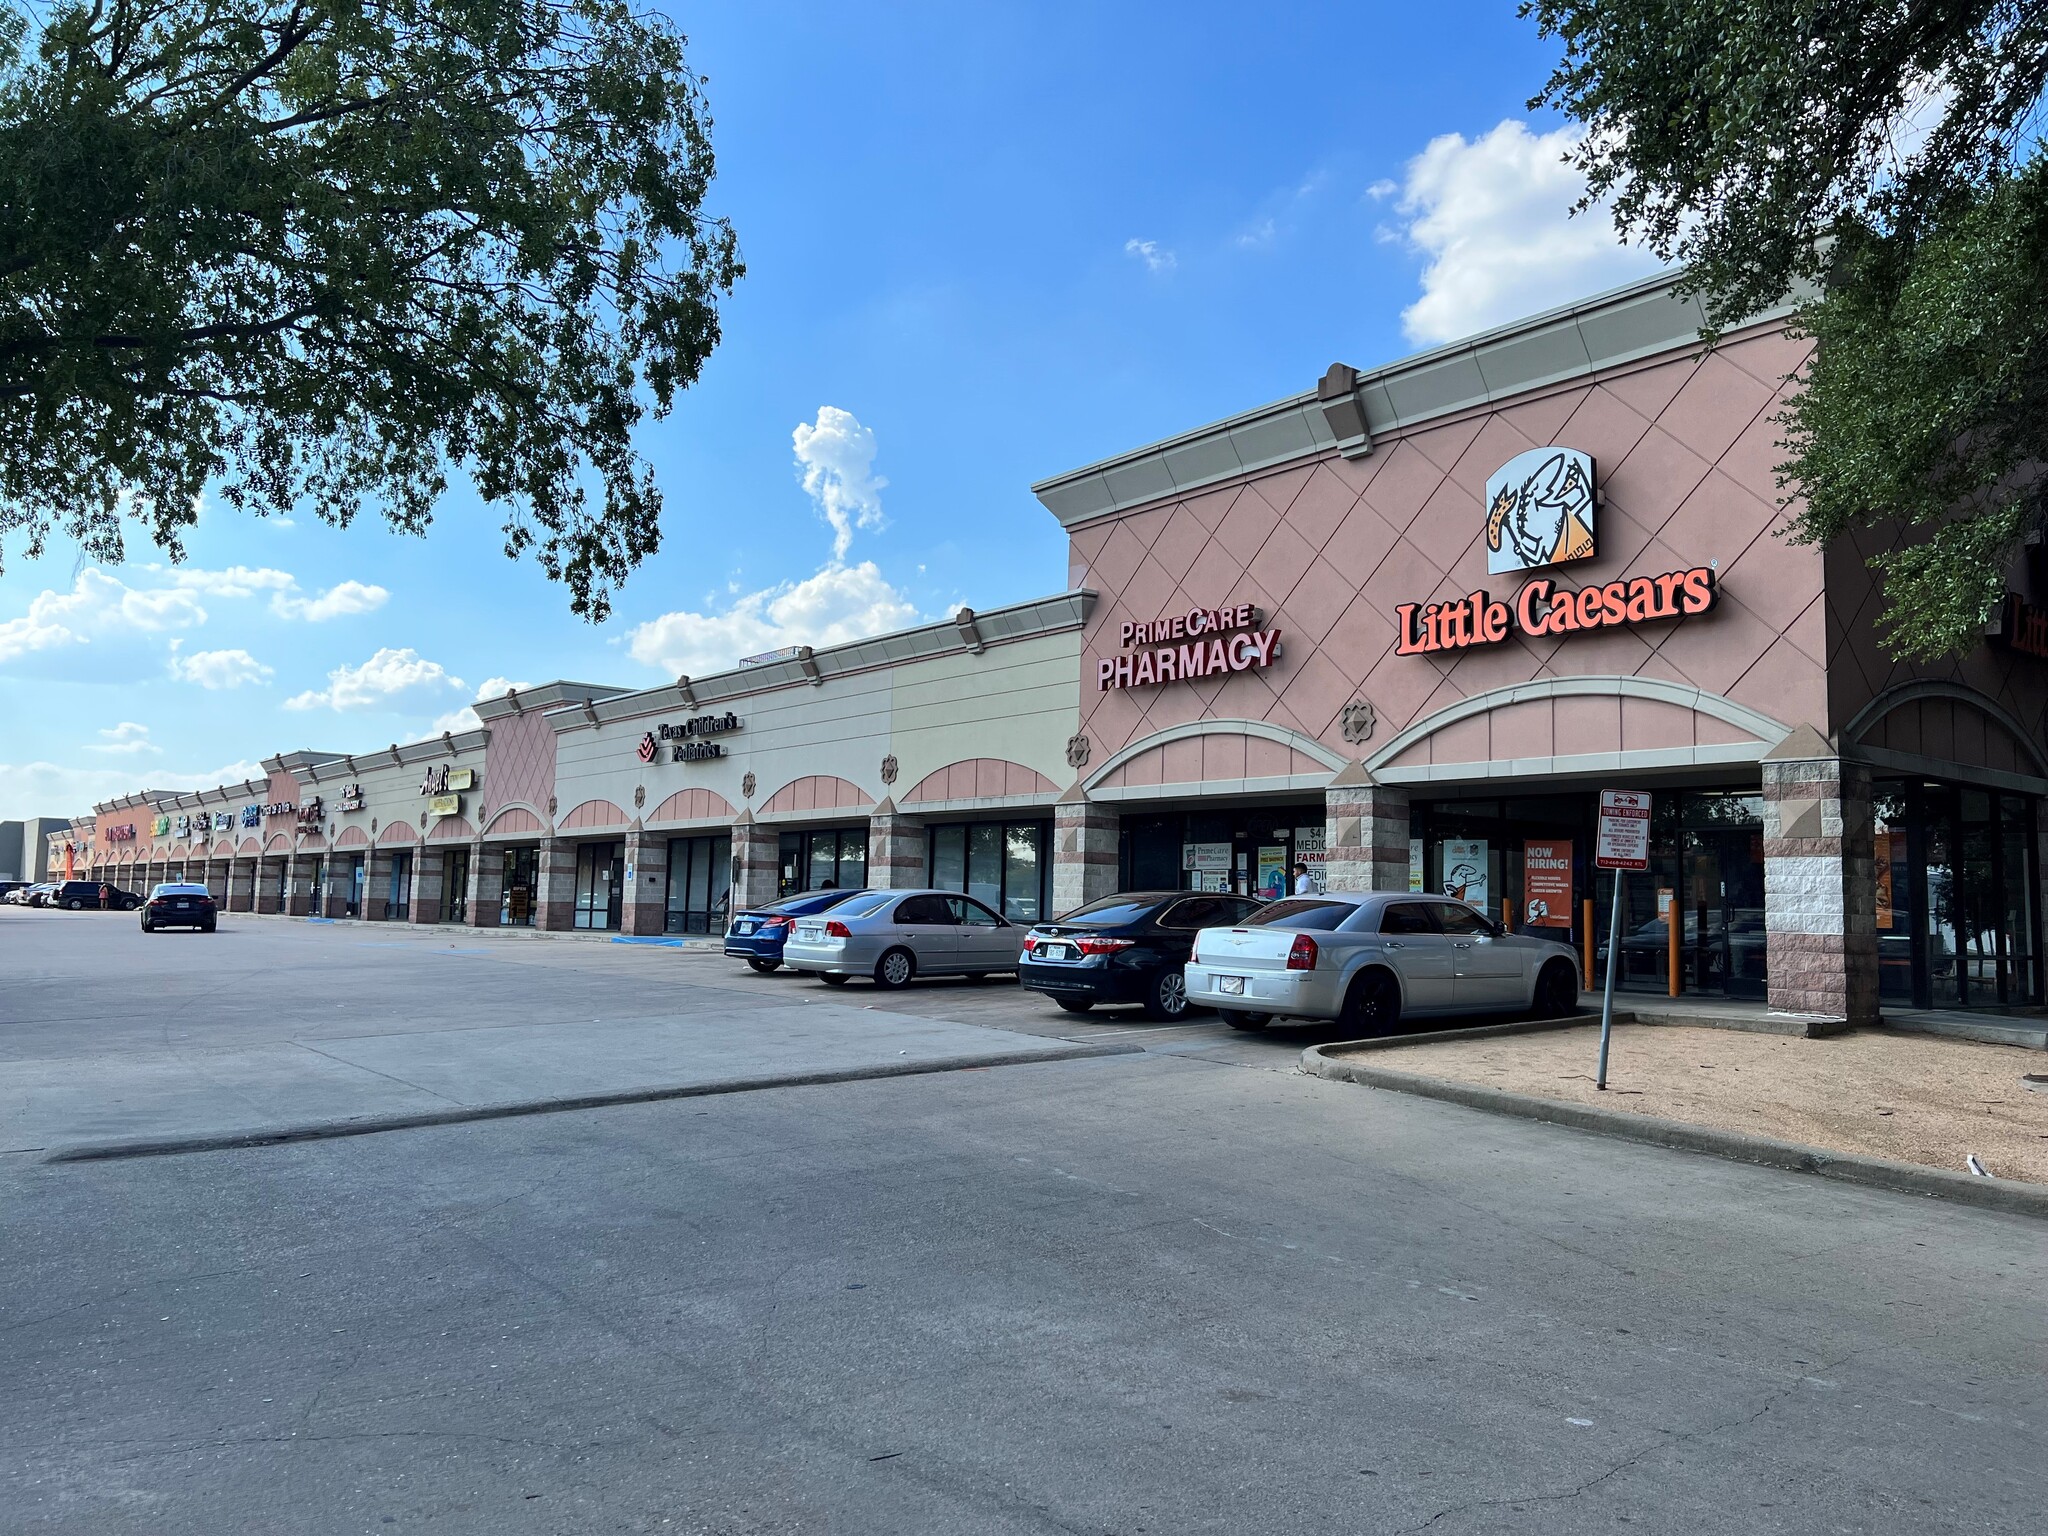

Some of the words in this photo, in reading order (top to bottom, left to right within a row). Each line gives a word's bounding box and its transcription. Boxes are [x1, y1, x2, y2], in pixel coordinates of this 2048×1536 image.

[1395, 590, 1513, 656] Little
[1517, 567, 1715, 637] Caesars
[1098, 629, 1281, 691] PHARMACY
[658, 724, 686, 740] Texas
[686, 712, 736, 736] Children's
[671, 741, 719, 762] Pediatrics
[1603, 808, 1622, 816] TOWING
[1623, 809, 1648, 818] ENFORCED
[1310, 828, 1326, 838] $4.
[1297, 853, 1326, 862] FARM
[1527, 847, 1553, 858] NOW
[1527, 858, 1569, 870] HIRING!
